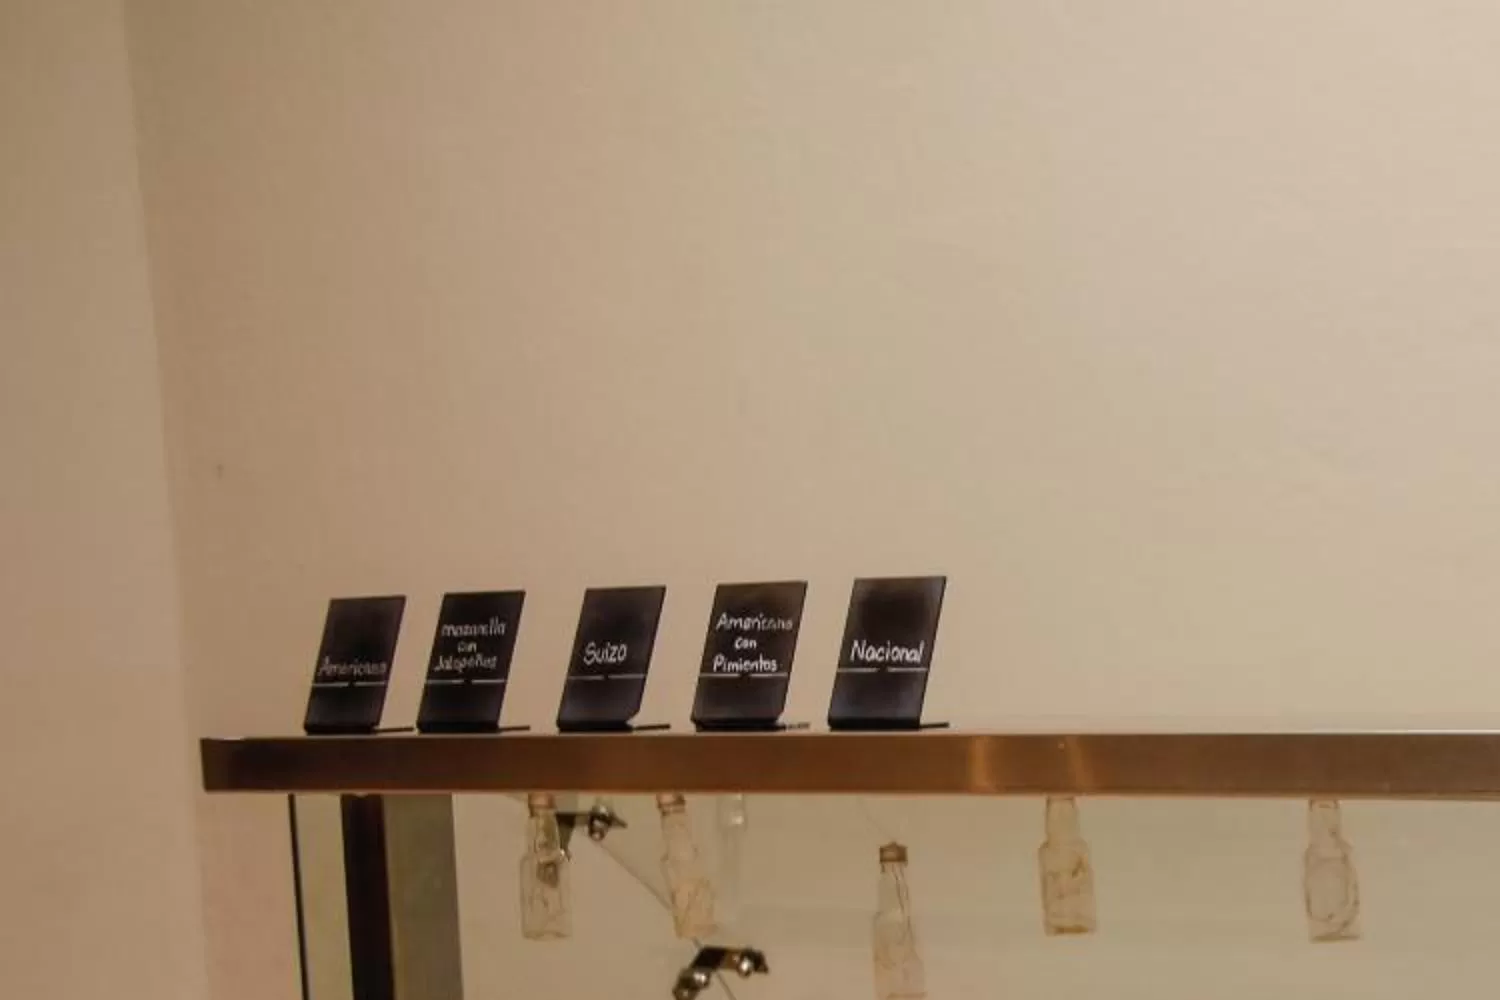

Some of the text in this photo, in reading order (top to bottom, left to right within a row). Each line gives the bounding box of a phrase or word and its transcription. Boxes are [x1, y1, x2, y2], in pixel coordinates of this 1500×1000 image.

[715, 612, 793, 632] Americano
[734, 636, 757, 649] con
[850, 639, 924, 663] Nacional
[583, 641, 627, 665] Suizo
[713, 655, 778, 672] Pimientos
